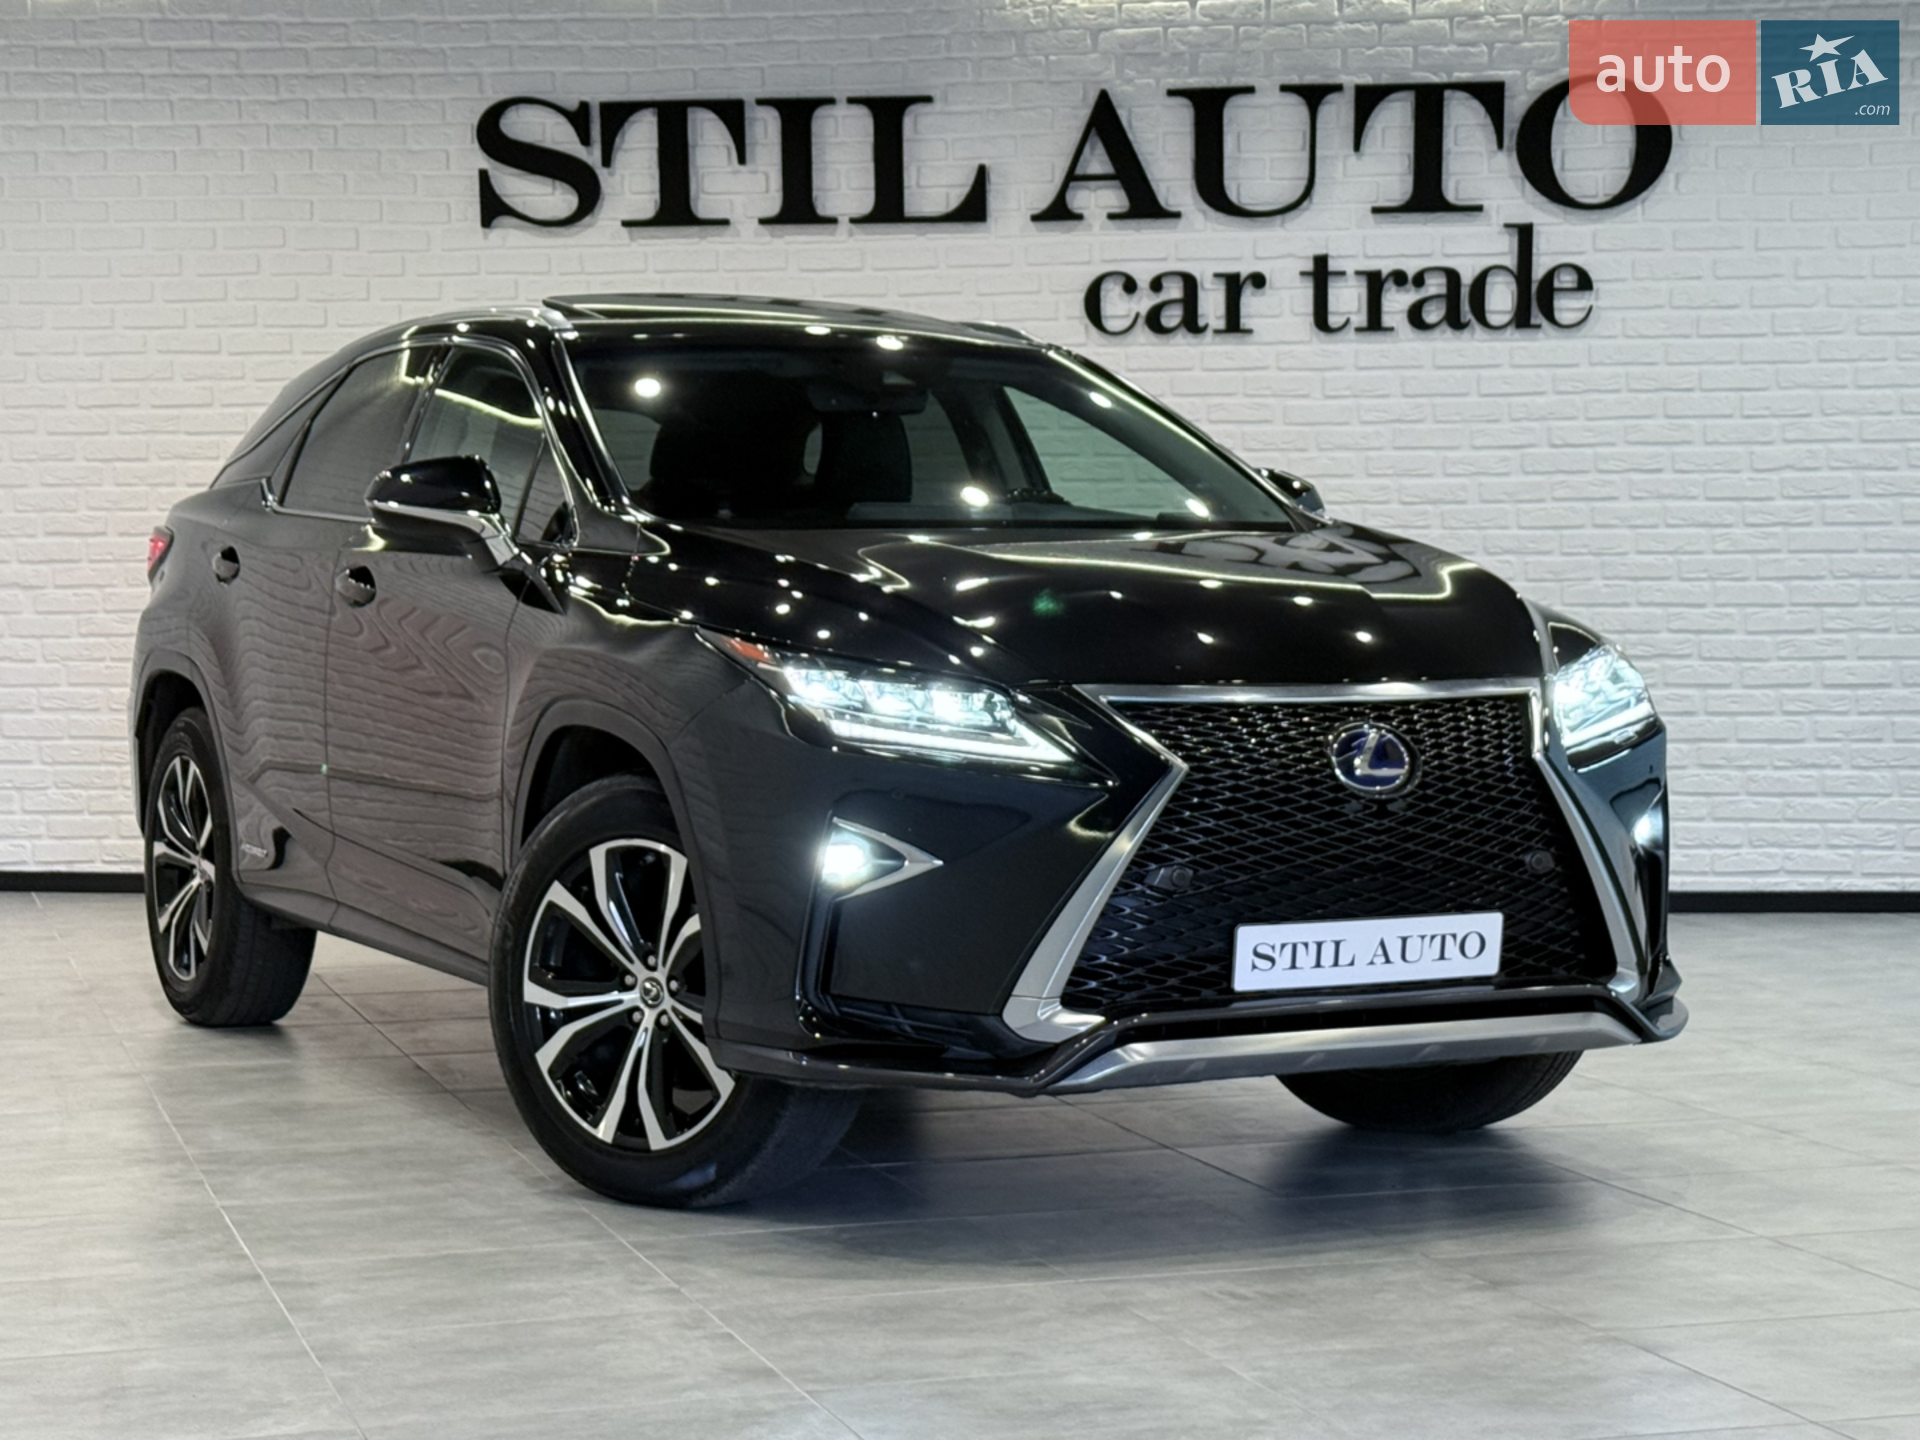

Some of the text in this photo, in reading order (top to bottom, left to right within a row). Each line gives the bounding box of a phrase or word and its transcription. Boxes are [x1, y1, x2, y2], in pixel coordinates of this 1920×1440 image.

[476, 75, 1673, 229] STIL AUTO
[1084, 223, 1594, 336] car trade
[1251, 931, 1487, 972] STIL AUTO
